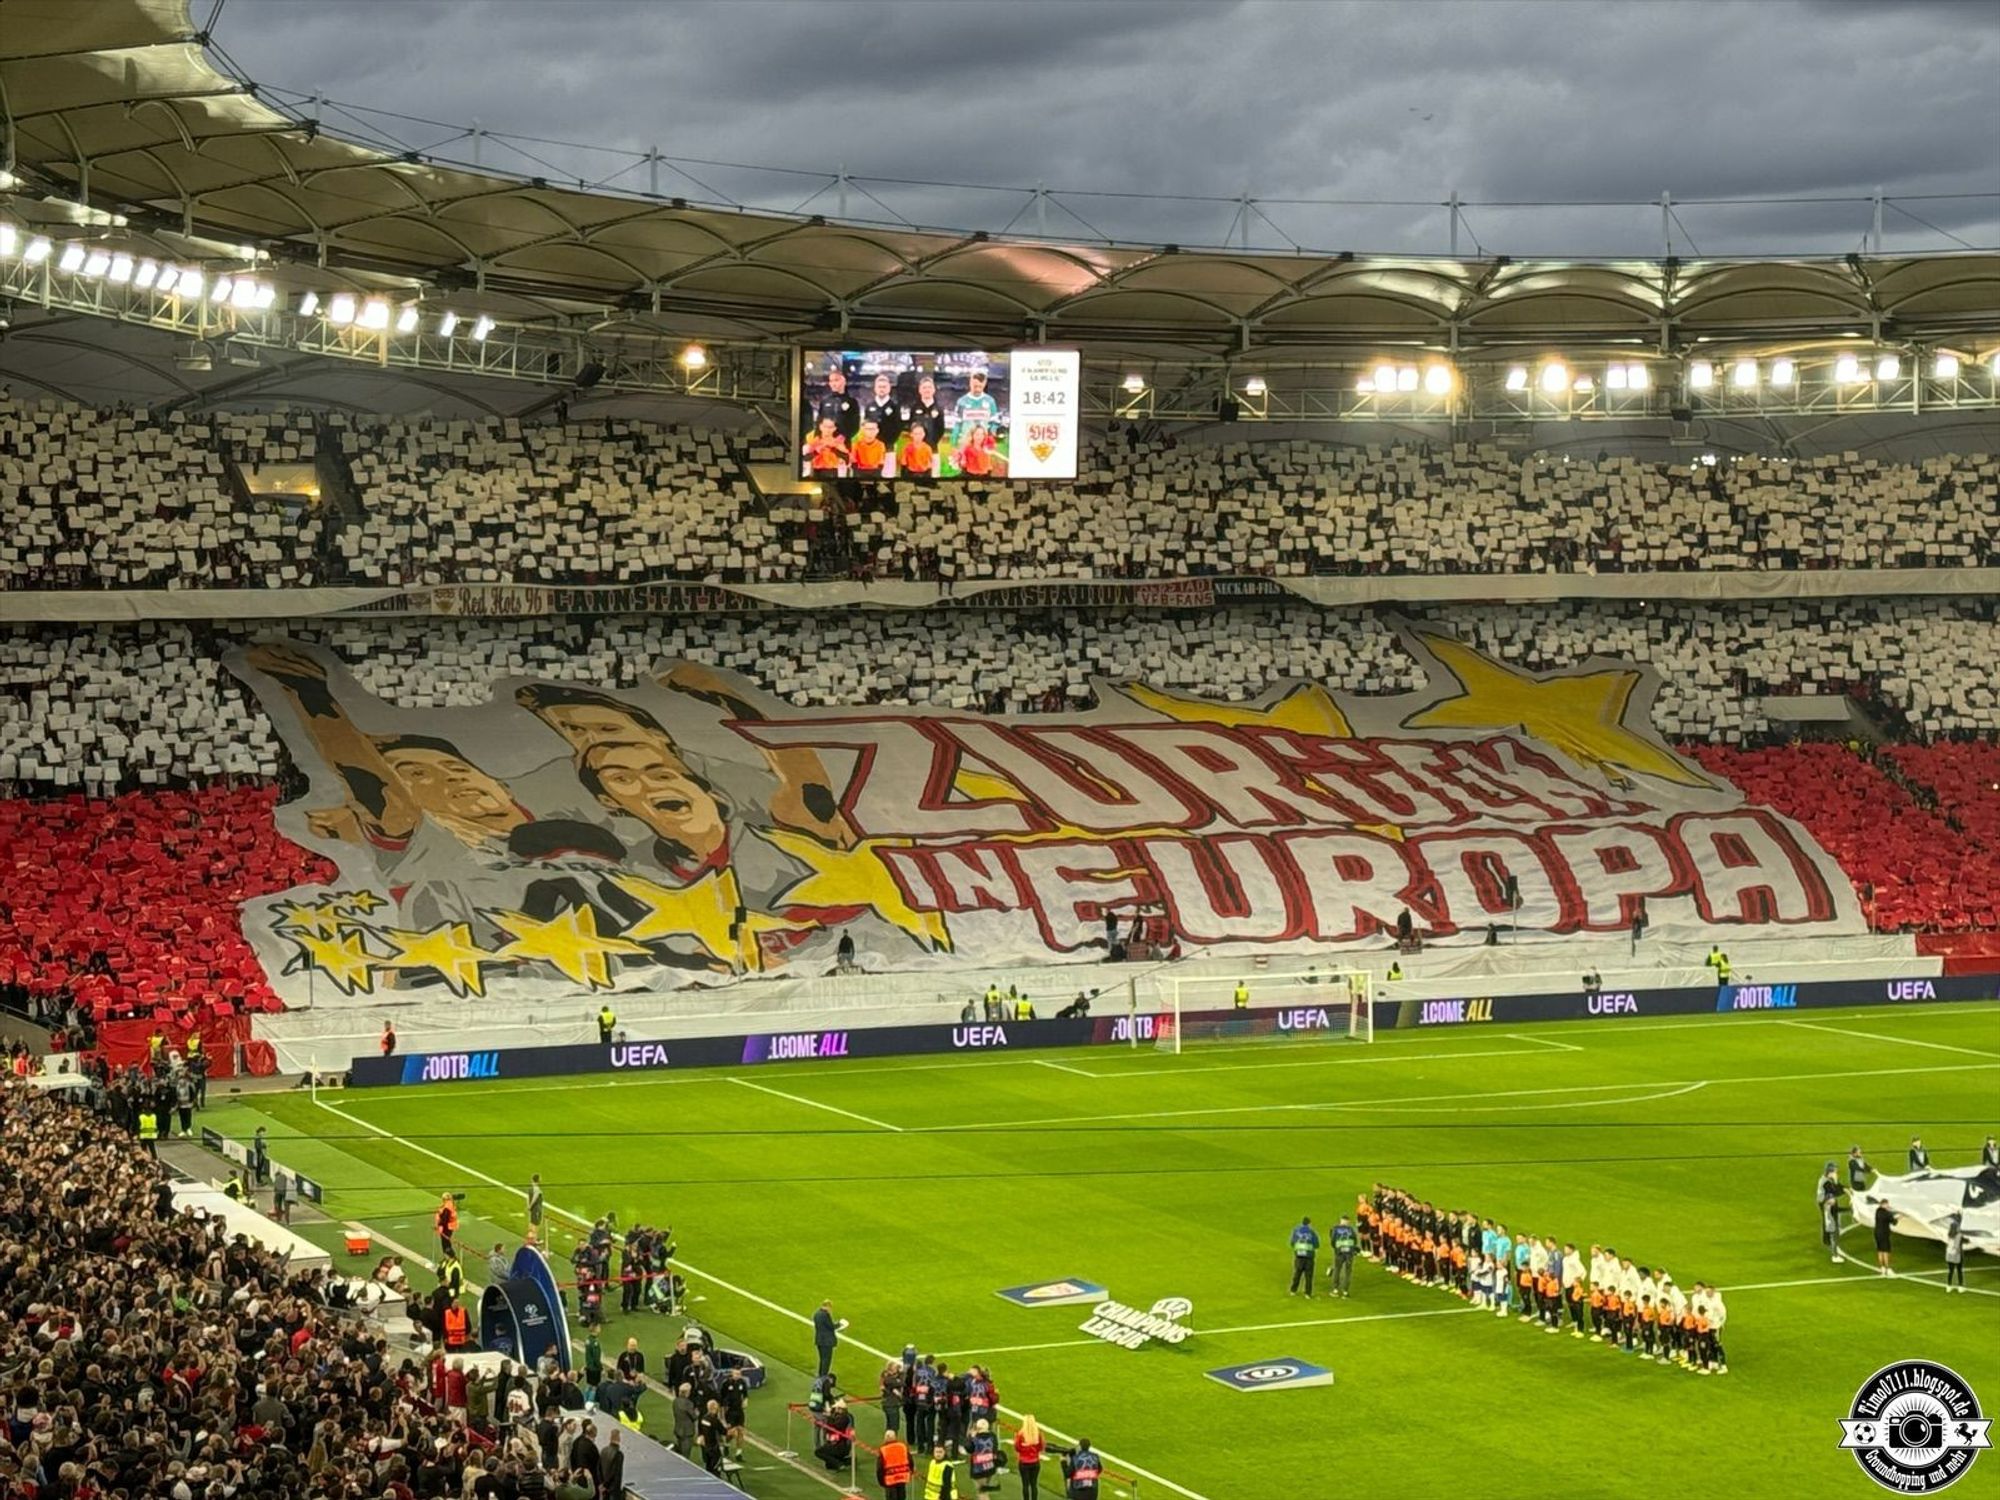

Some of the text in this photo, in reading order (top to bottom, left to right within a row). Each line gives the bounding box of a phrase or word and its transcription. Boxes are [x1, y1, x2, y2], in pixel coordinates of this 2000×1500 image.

[1023, 391, 1066, 405] 18:42
[458, 586, 487, 614] Red
[525, 587, 543, 613] 96
[871, 806, 1838, 953] IN EUROPA
[1887, 979, 1936, 1001] UEFA
[1466, 998, 1494, 1022] ALL
[1587, 994, 1639, 1014] UEFA
[1278, 1008, 1330, 1030] UEFA
[818, 1031, 849, 1057] ALL
[953, 1027, 1008, 1048] UEFA
[611, 1045, 669, 1067] UEFA
[1078, 1315, 1151, 1350] LEAGUE
[1092, 1300, 1194, 1344] CHAMPIONS
